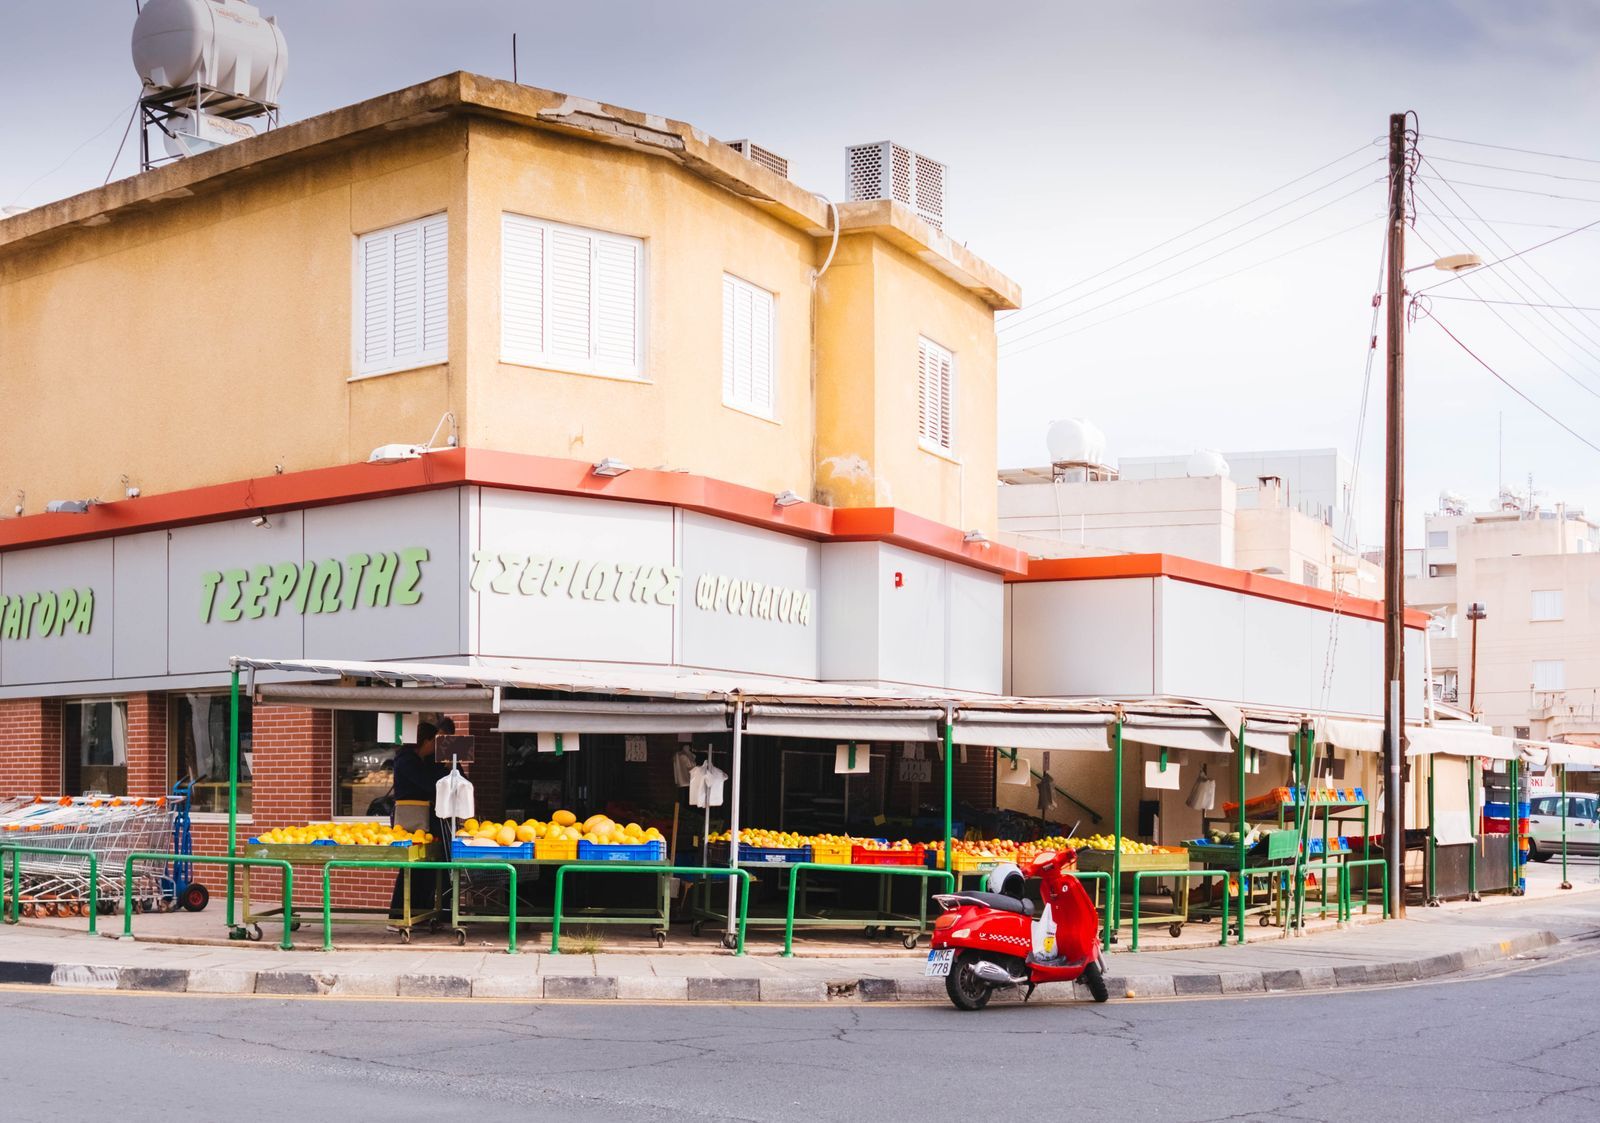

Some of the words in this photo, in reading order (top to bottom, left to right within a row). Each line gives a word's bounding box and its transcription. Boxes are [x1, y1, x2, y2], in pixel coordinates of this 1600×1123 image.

[200, 546, 430, 624] ΤΣΕΡΙΩΤΗΣ
[469, 549, 682, 606] ΤΣΕΡΙΩΤΗΣ
[931, 962, 949, 974] 778
[933, 950, 952, 961] MKE
